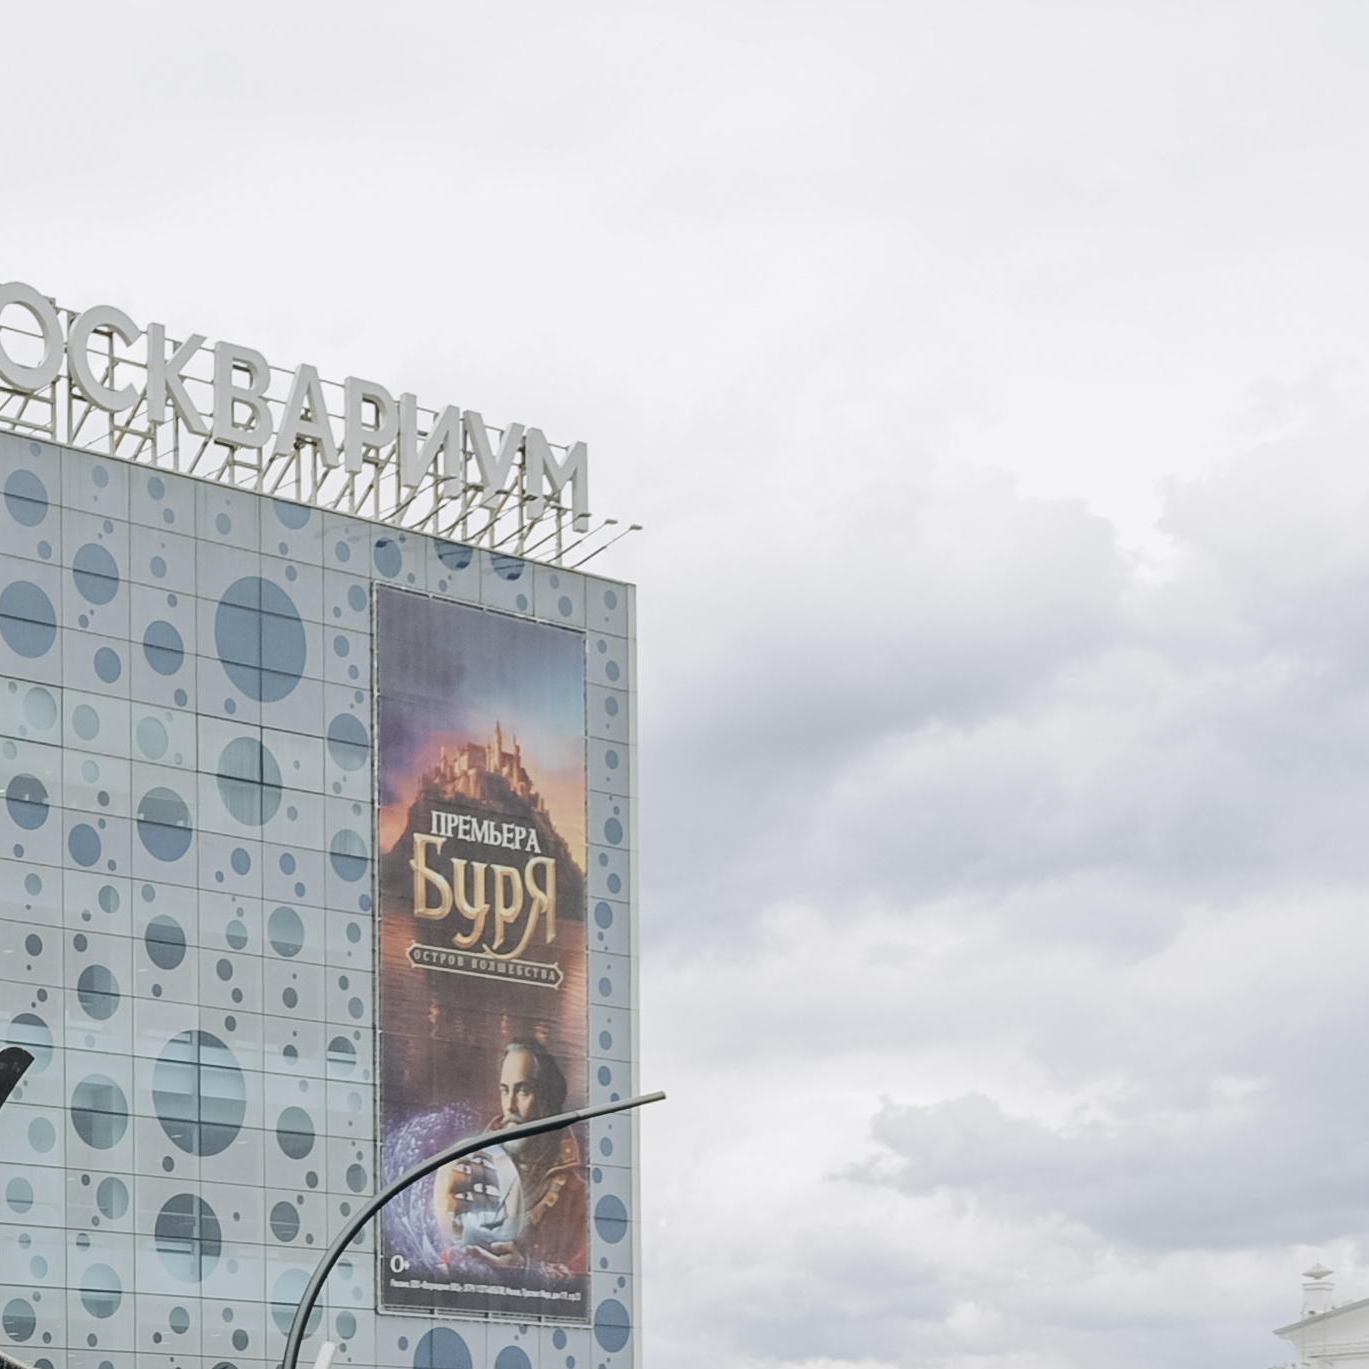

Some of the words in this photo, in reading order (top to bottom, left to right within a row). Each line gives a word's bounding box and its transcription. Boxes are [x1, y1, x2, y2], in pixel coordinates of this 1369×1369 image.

[430, 810, 542, 853] ПРЕМЬЕРА
[413, 950, 465, 967] ОСТРОВ
[471, 960, 557, 981] ВОЛШЕБСТВА
